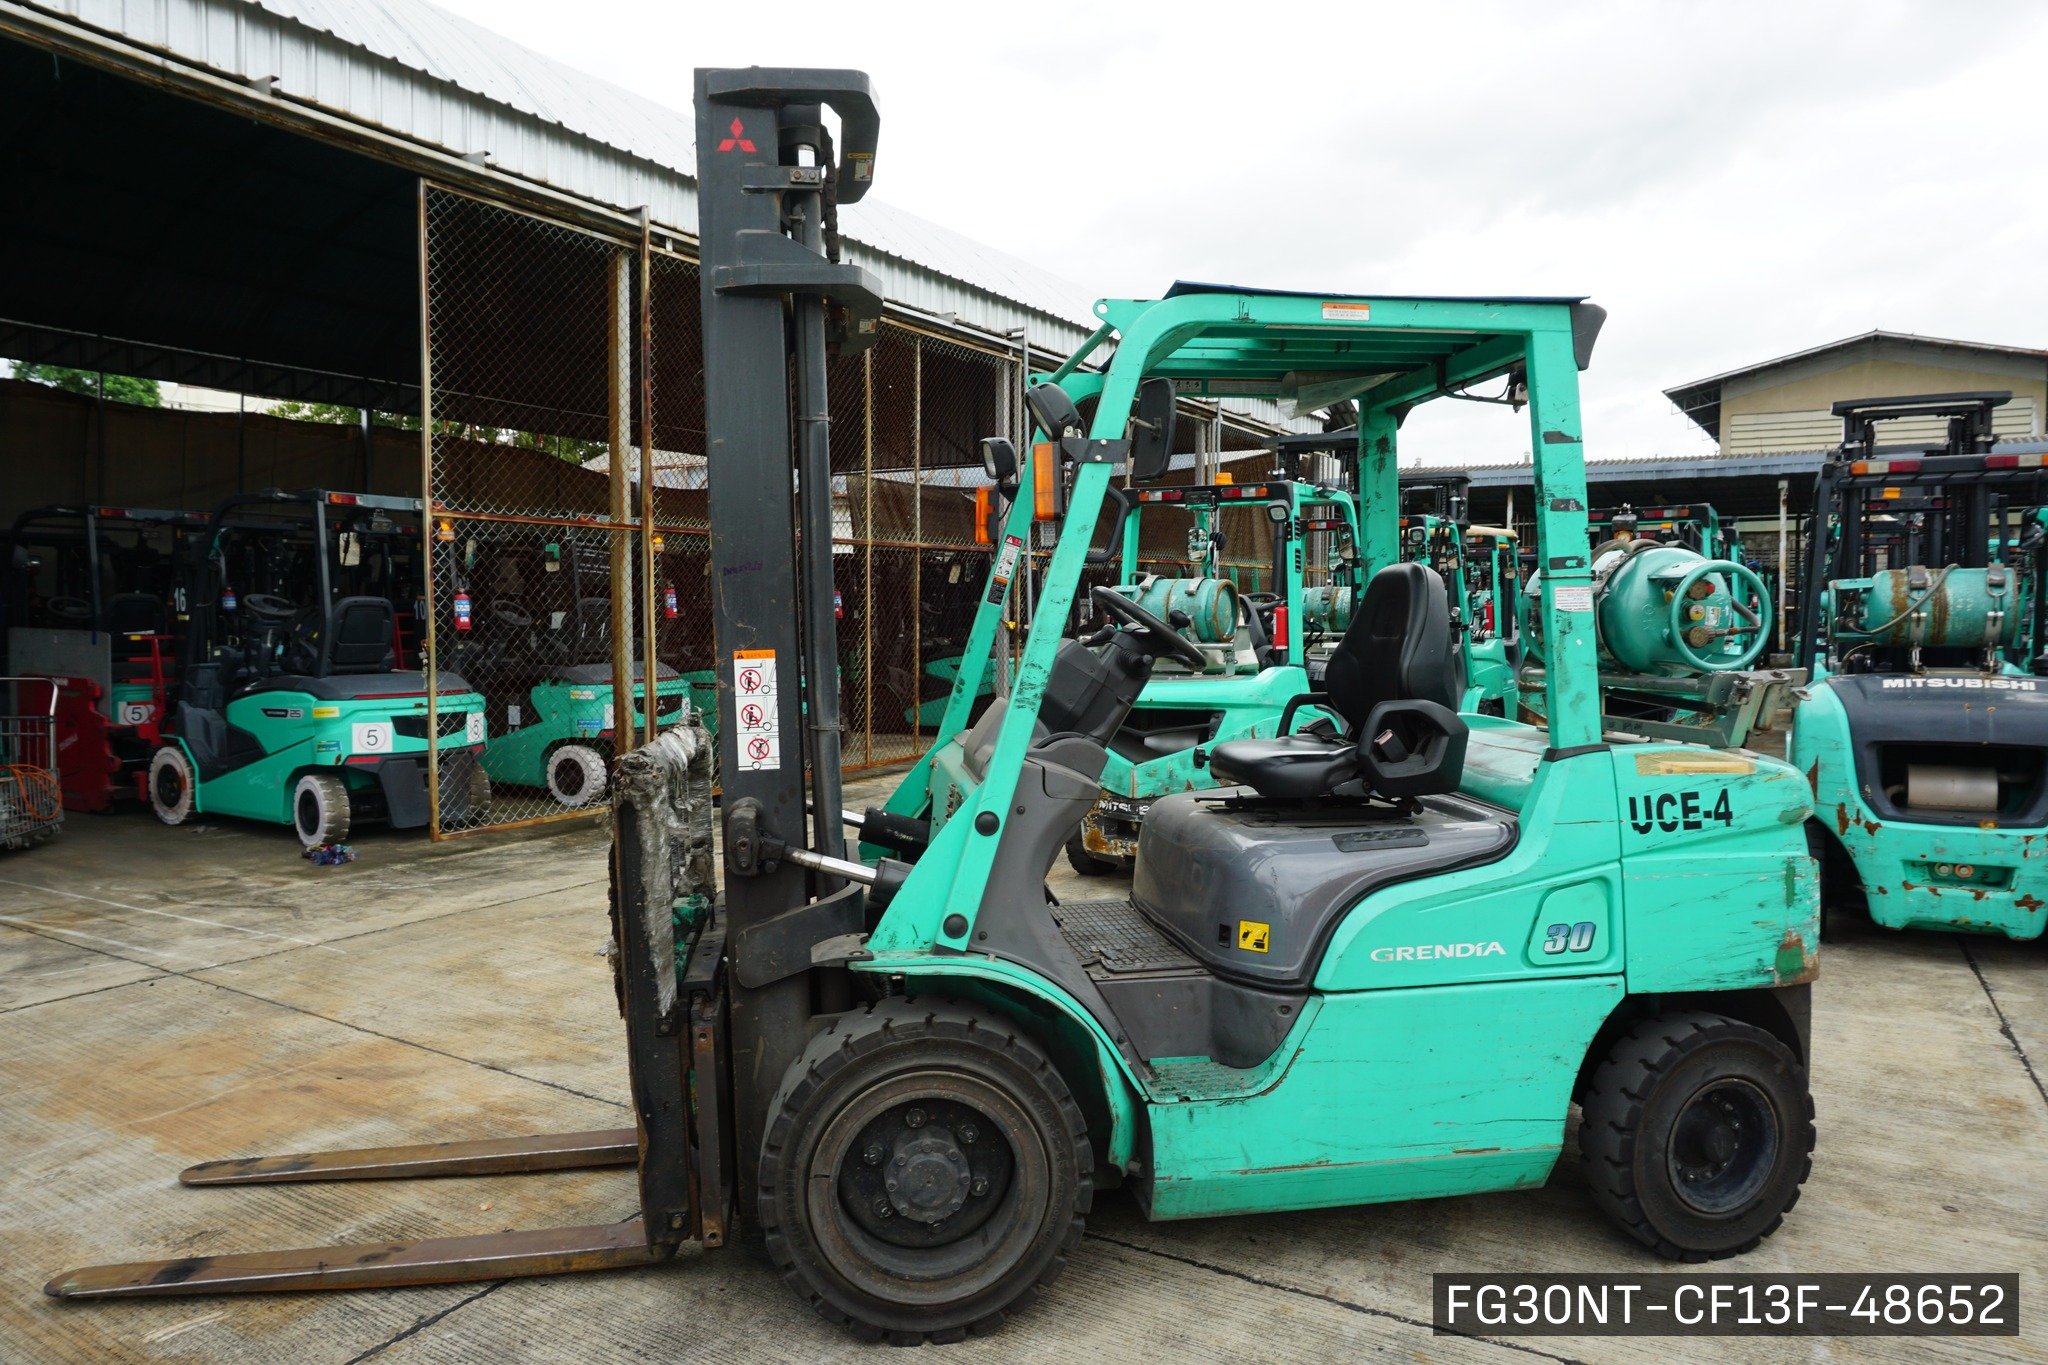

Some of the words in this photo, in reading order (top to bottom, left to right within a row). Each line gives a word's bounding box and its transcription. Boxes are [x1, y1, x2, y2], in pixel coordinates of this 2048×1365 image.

[173, 587, 187, 612] 16
[1882, 678, 2037, 691] MITSUBISHI
[131, 707, 142, 722] 5
[366, 729, 379, 746] 5
[1629, 788, 1734, 834] UCE-4
[1543, 921, 1597, 954] 30
